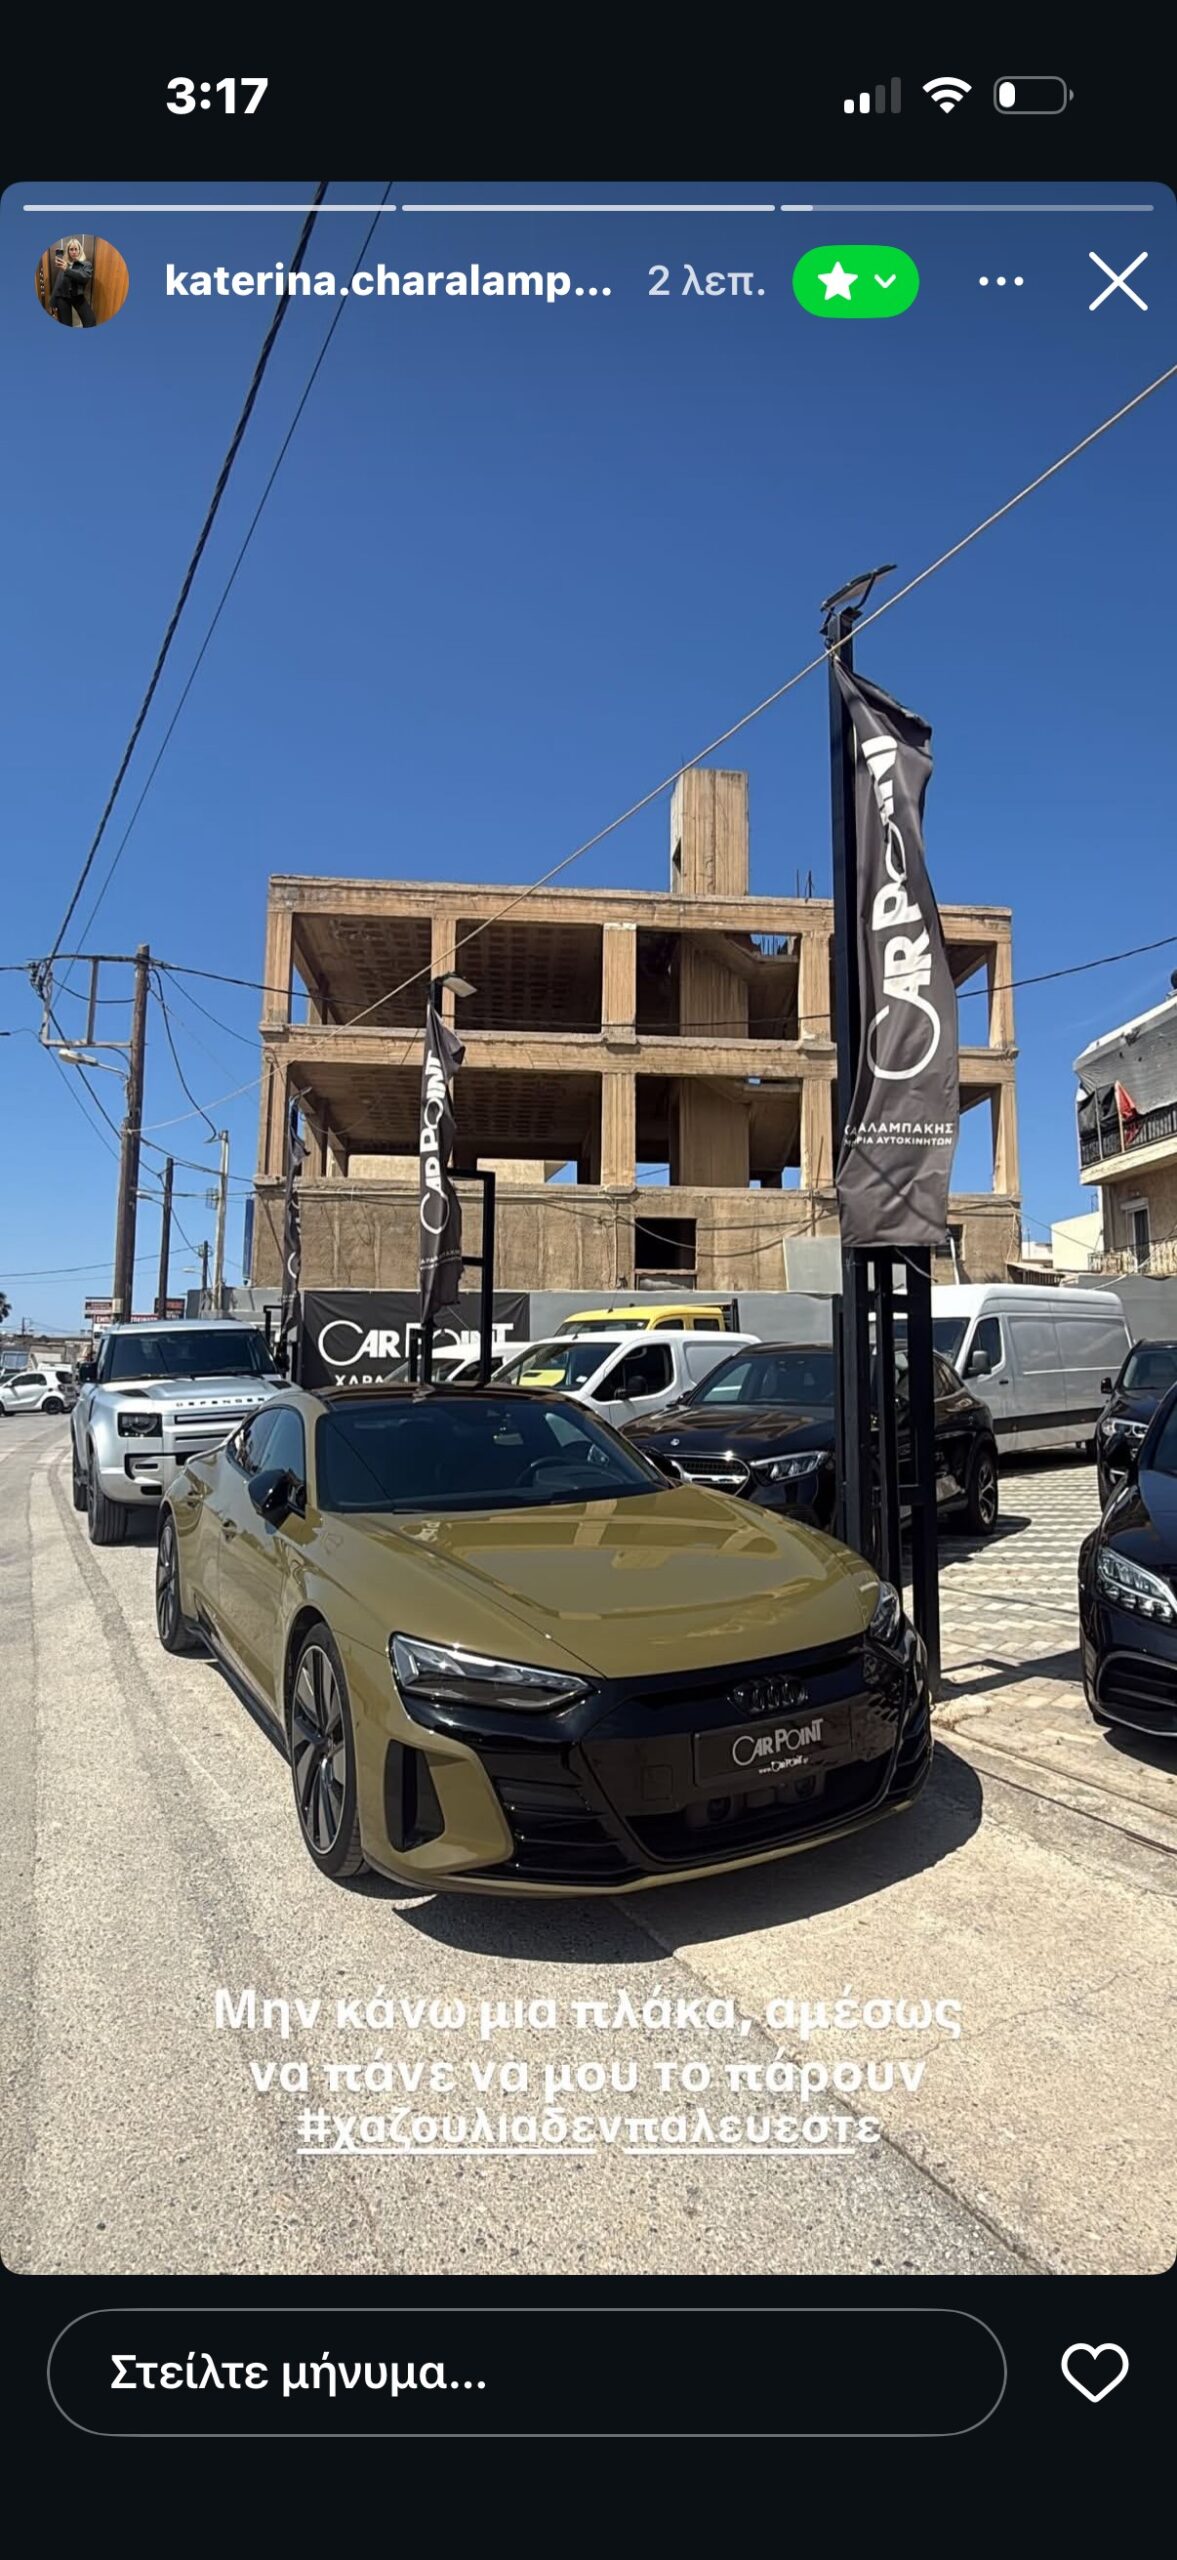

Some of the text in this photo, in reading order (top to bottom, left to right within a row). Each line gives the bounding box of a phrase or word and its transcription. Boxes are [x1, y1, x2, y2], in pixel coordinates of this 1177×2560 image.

[318, 1320, 400, 1366] CAR
[732, 1718, 824, 1766] CAR POINT
